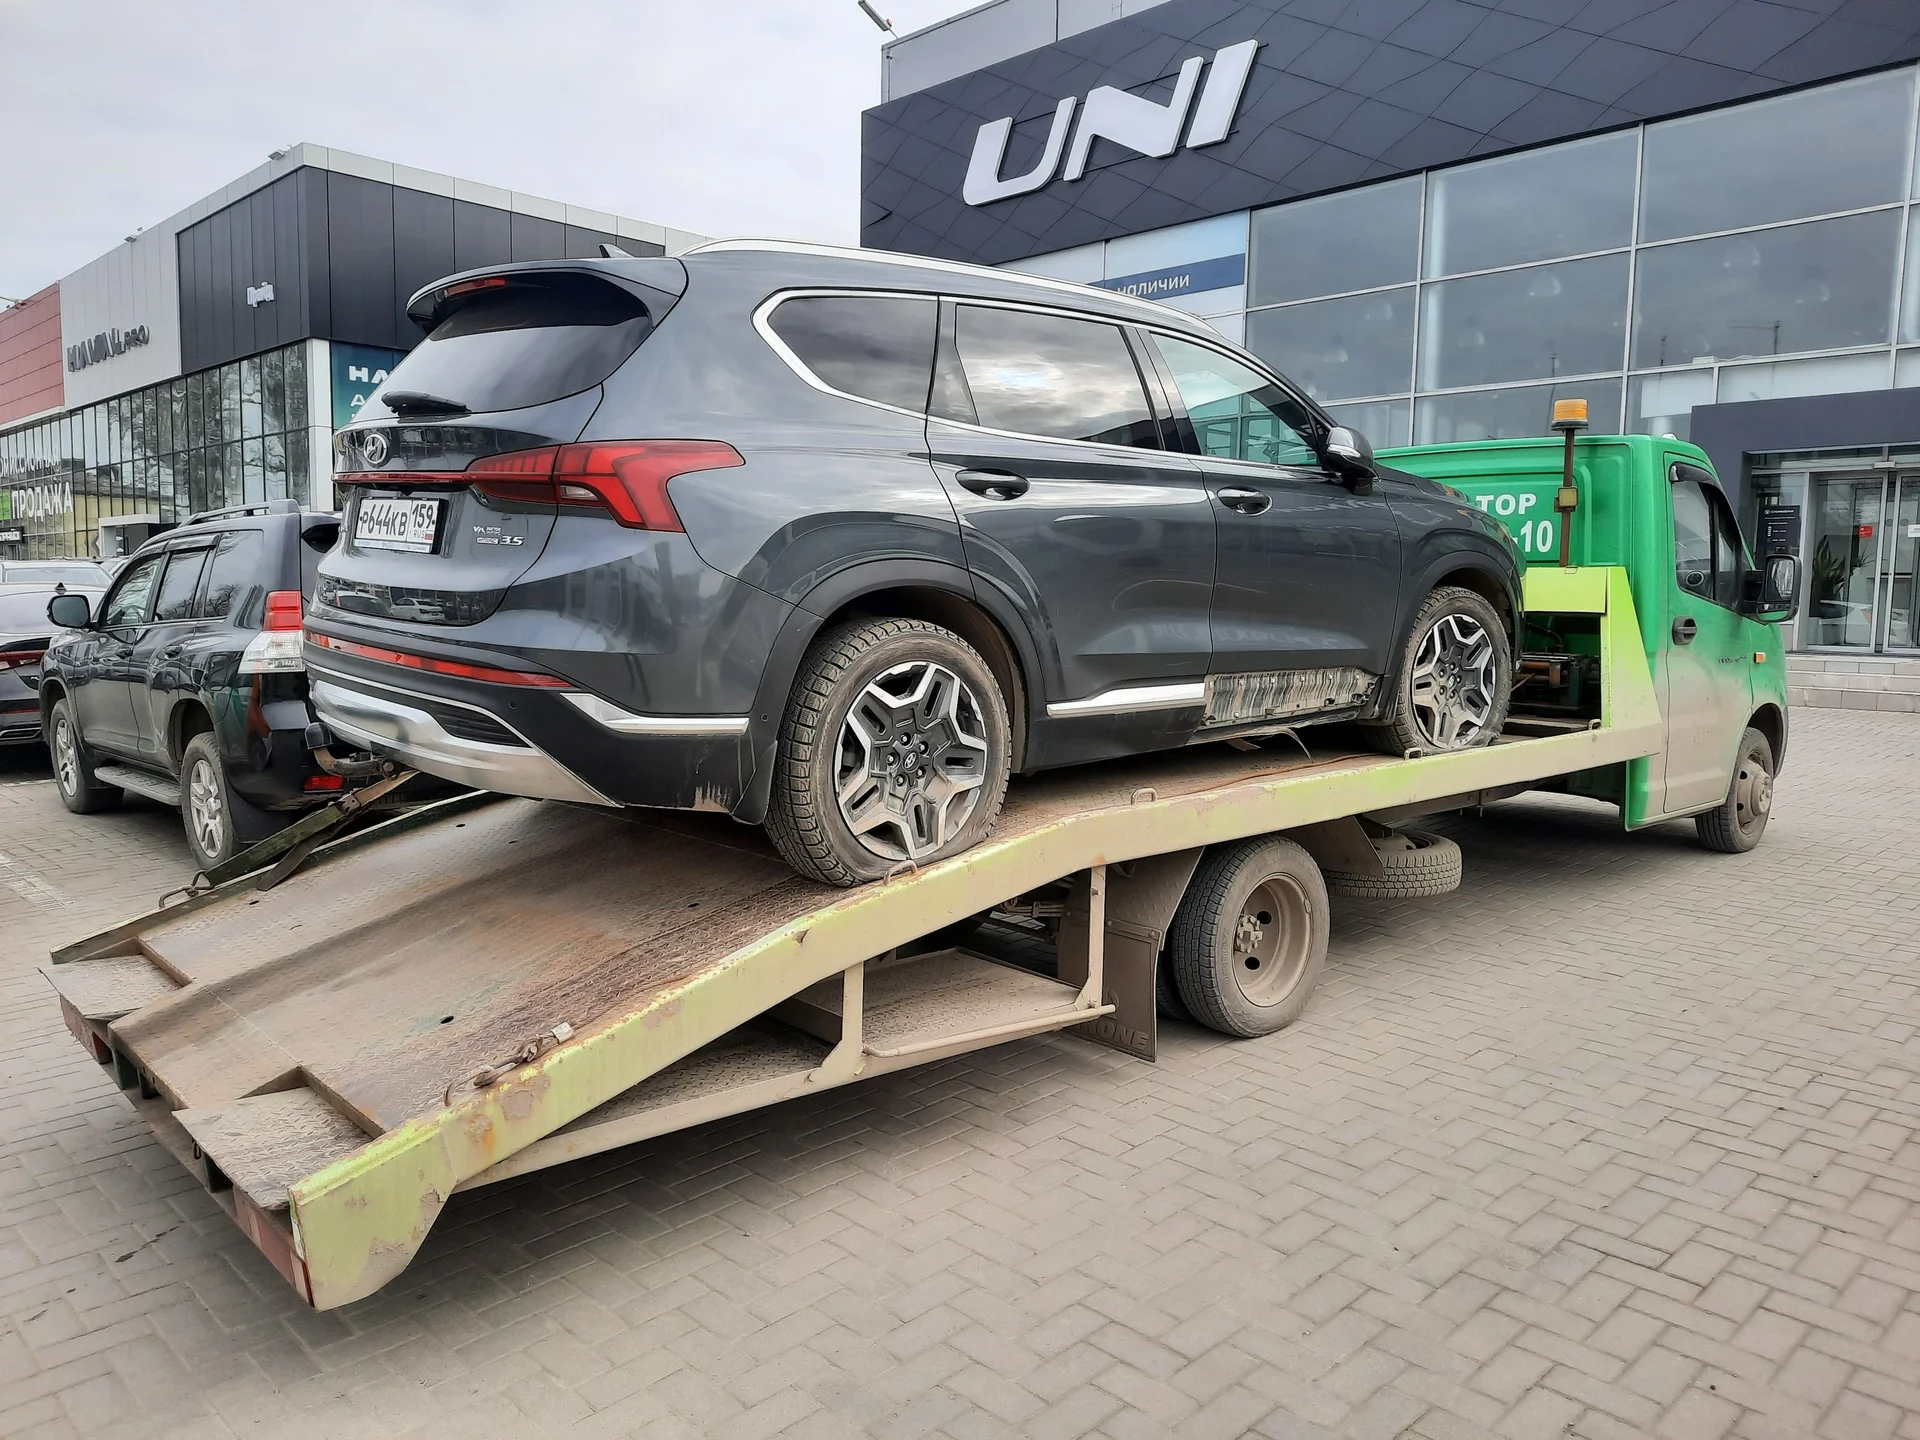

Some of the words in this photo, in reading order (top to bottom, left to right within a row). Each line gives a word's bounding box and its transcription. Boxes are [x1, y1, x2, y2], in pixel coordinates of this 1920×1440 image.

[962, 39, 1259, 206] UNI
[0, 447, 61, 478] ОМИССИОННАЯ
[12, 481, 73, 523] ПРОДАЖА
[412, 503, 434, 529] 159
[413, 529, 425, 539] RUS
